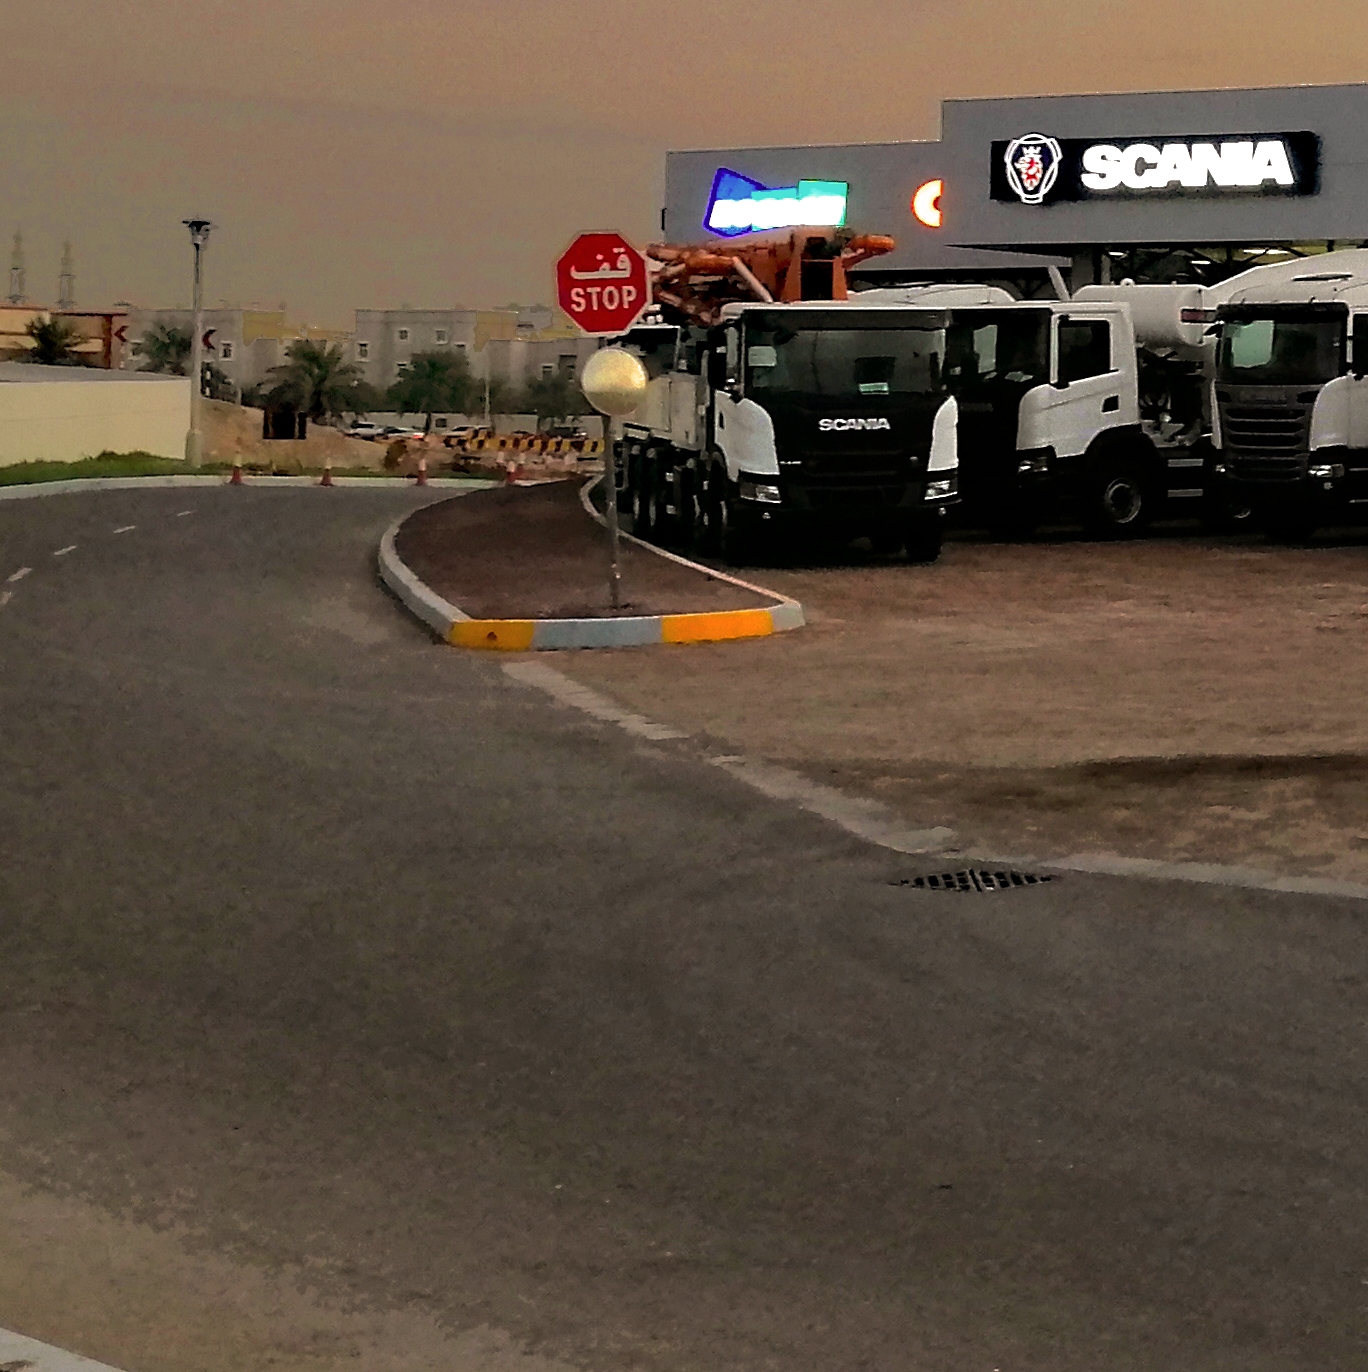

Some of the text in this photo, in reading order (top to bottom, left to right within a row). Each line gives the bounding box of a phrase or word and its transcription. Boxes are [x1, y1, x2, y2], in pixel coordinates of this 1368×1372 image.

[1080, 140, 1295, 190] SCANIA
[569, 247, 632, 280] قف
[570, 285, 637, 313] STOP
[818, 418, 891, 431] SCANIA
